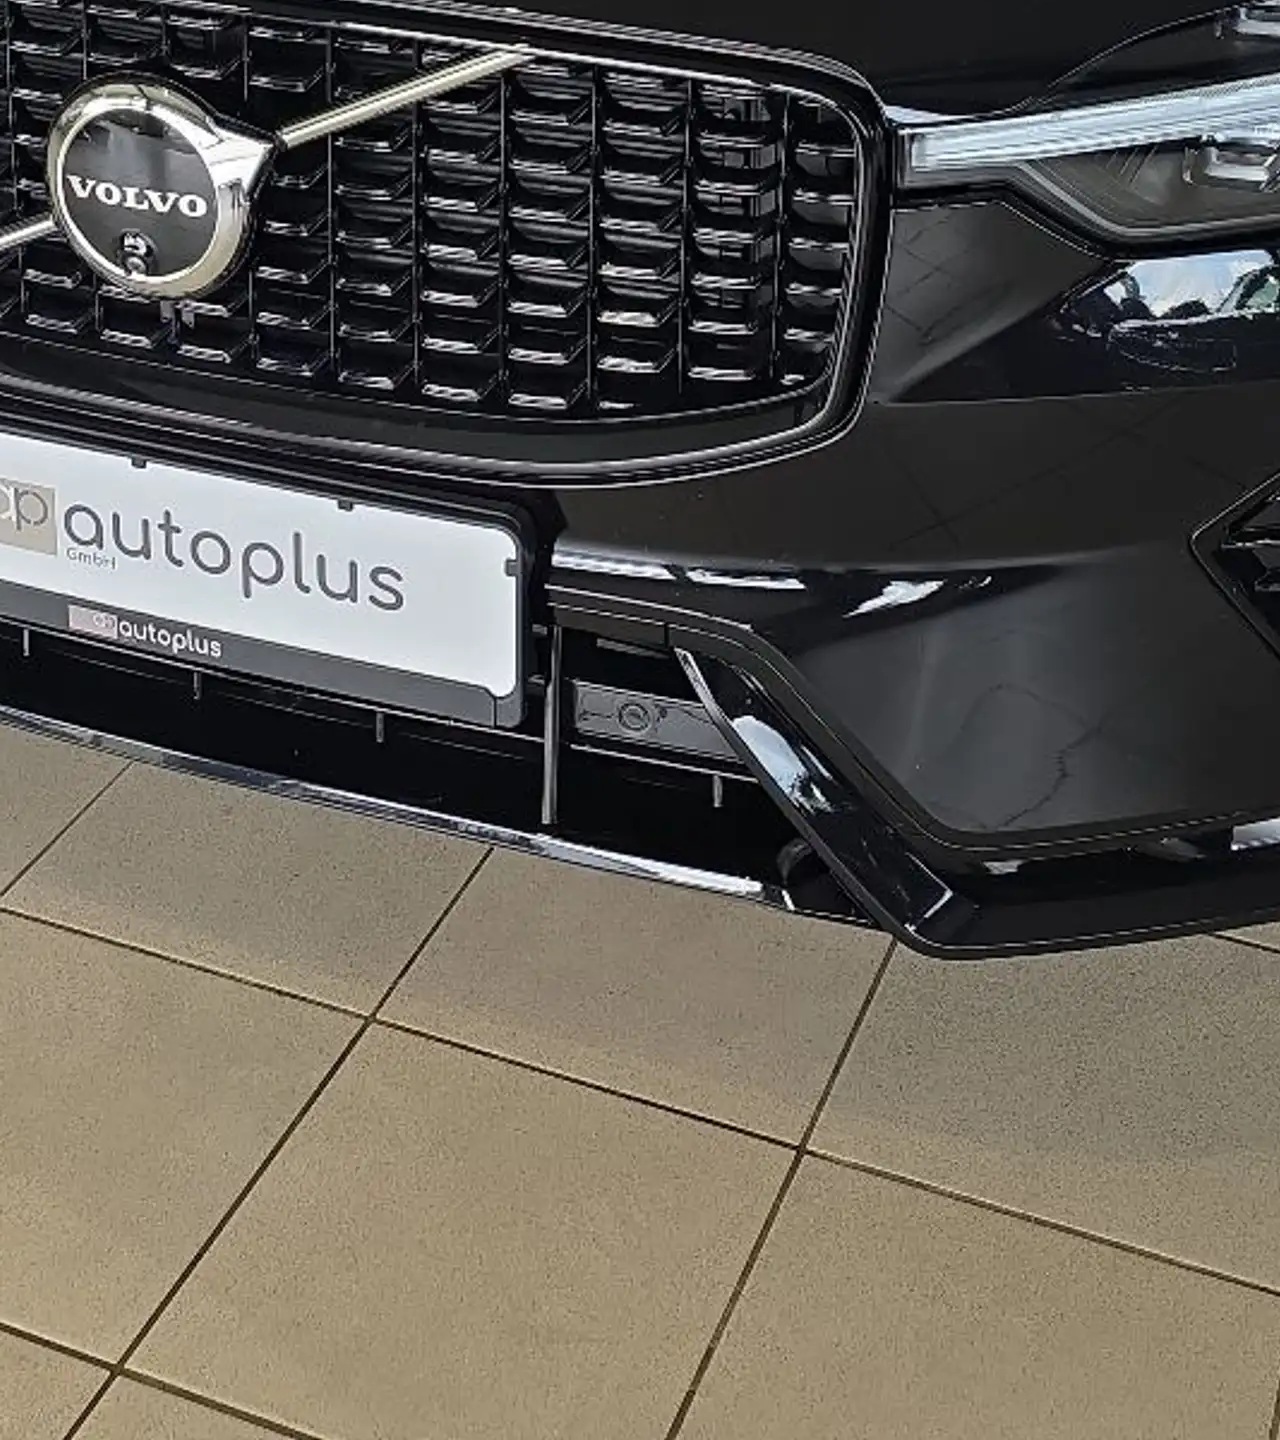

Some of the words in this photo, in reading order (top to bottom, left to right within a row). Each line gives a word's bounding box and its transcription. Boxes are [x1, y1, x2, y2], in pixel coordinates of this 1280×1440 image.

[66, 174, 208, 218] VOLVO
[63, 503, 405, 611] autoplus
[66, 547, 117, 570] GmbH
[119, 620, 222, 658] autoplus
